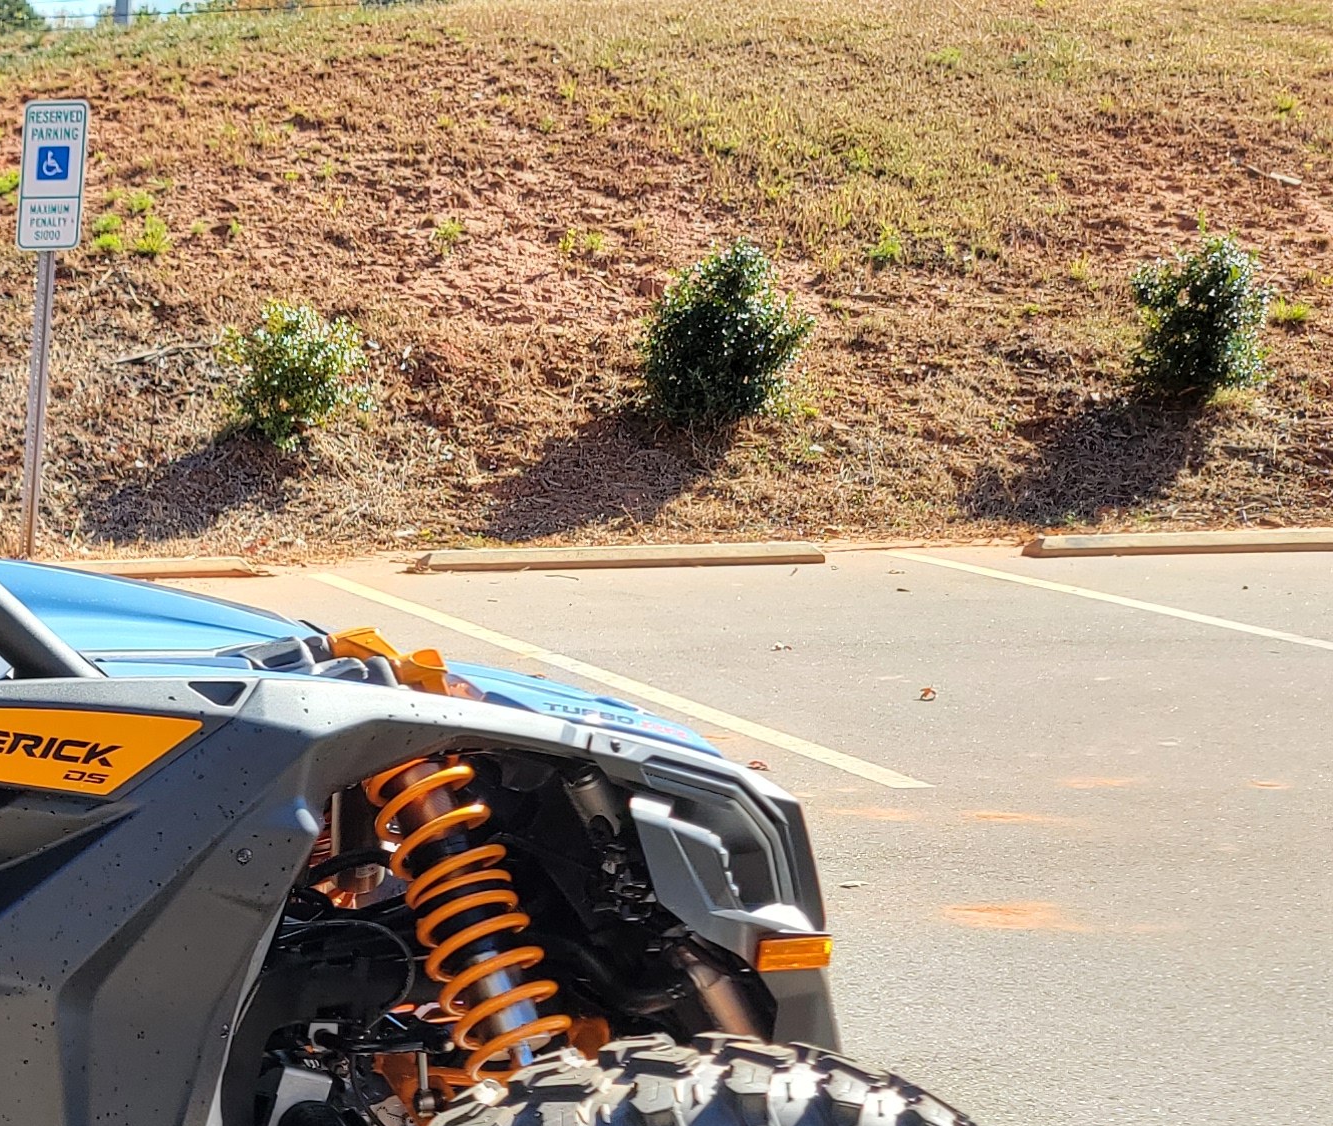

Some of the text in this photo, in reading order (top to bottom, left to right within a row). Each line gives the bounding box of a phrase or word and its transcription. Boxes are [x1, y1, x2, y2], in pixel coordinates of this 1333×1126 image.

[28, 109, 83, 124] RESERVED
[30, 126, 79, 141] PARKING
[29, 203, 70, 214] MAXIMUM
[29, 217, 67, 228] PENALTY
